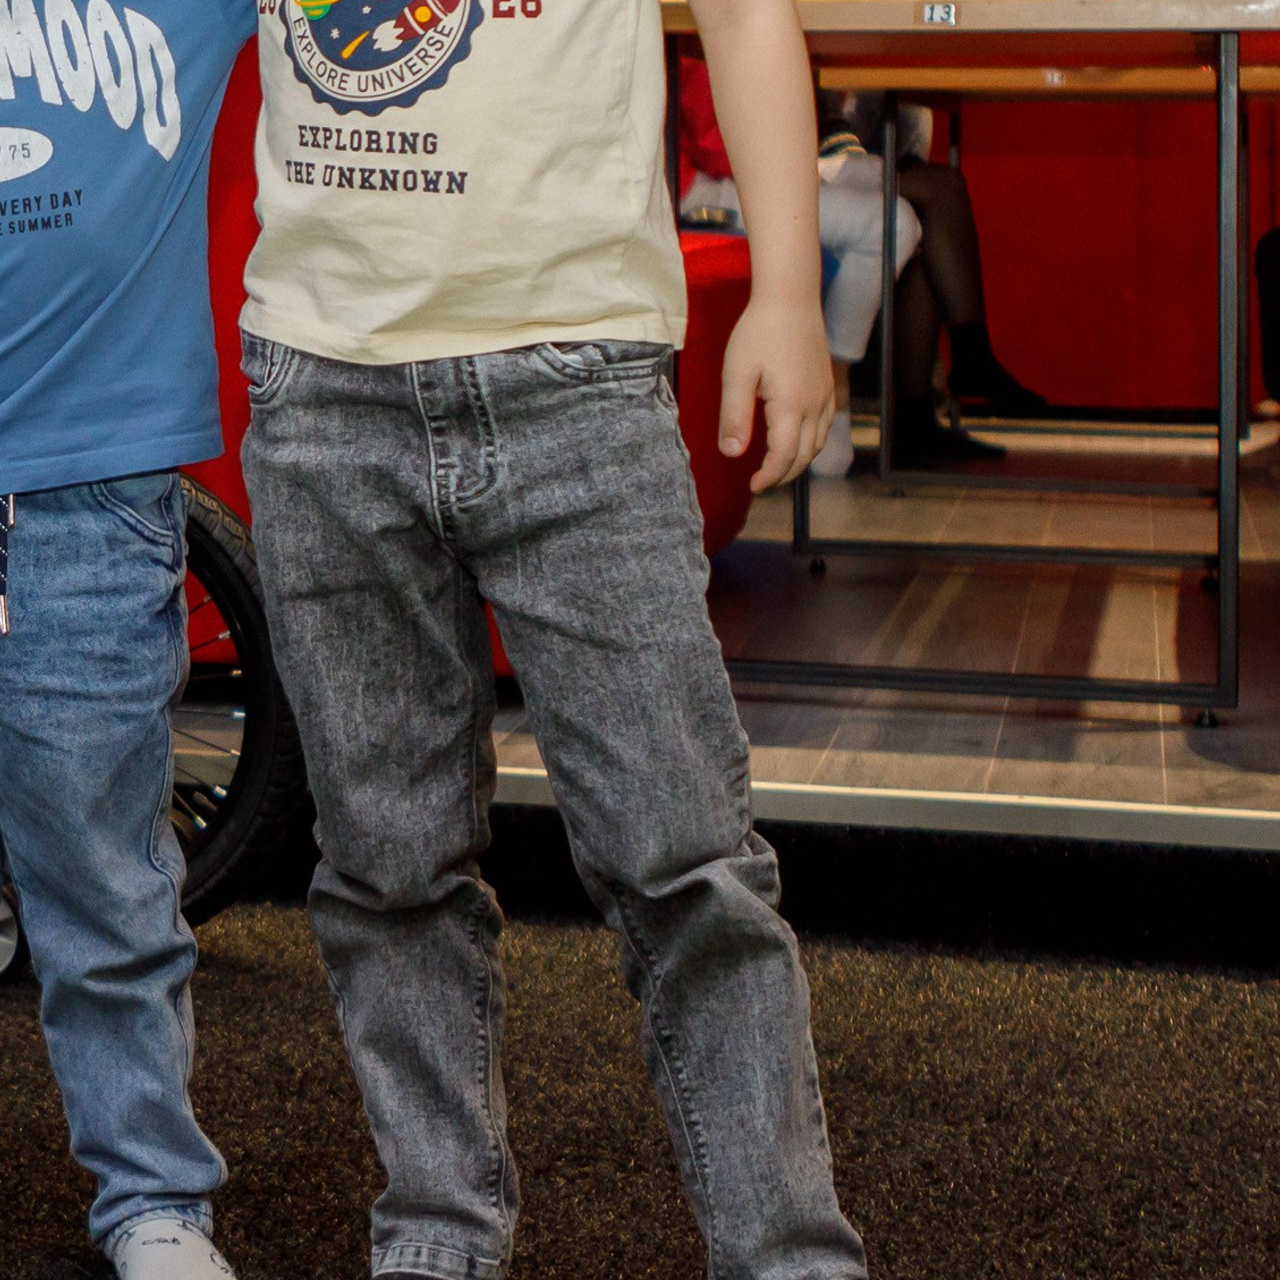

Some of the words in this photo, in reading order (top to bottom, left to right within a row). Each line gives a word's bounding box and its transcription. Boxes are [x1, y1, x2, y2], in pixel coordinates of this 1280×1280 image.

[927, 4, 952, 22] 13
[293, 16, 351, 92] EXPLORE
[357, 23, 454, 93] UNIVERSE
[298, 124, 438, 155] EXPLORING
[285, 159, 316, 185] THE
[322, 164, 469, 195] UNKNOWN
[49, 189, 83, 210] DAY
[8, 213, 74, 235] SUMMER
